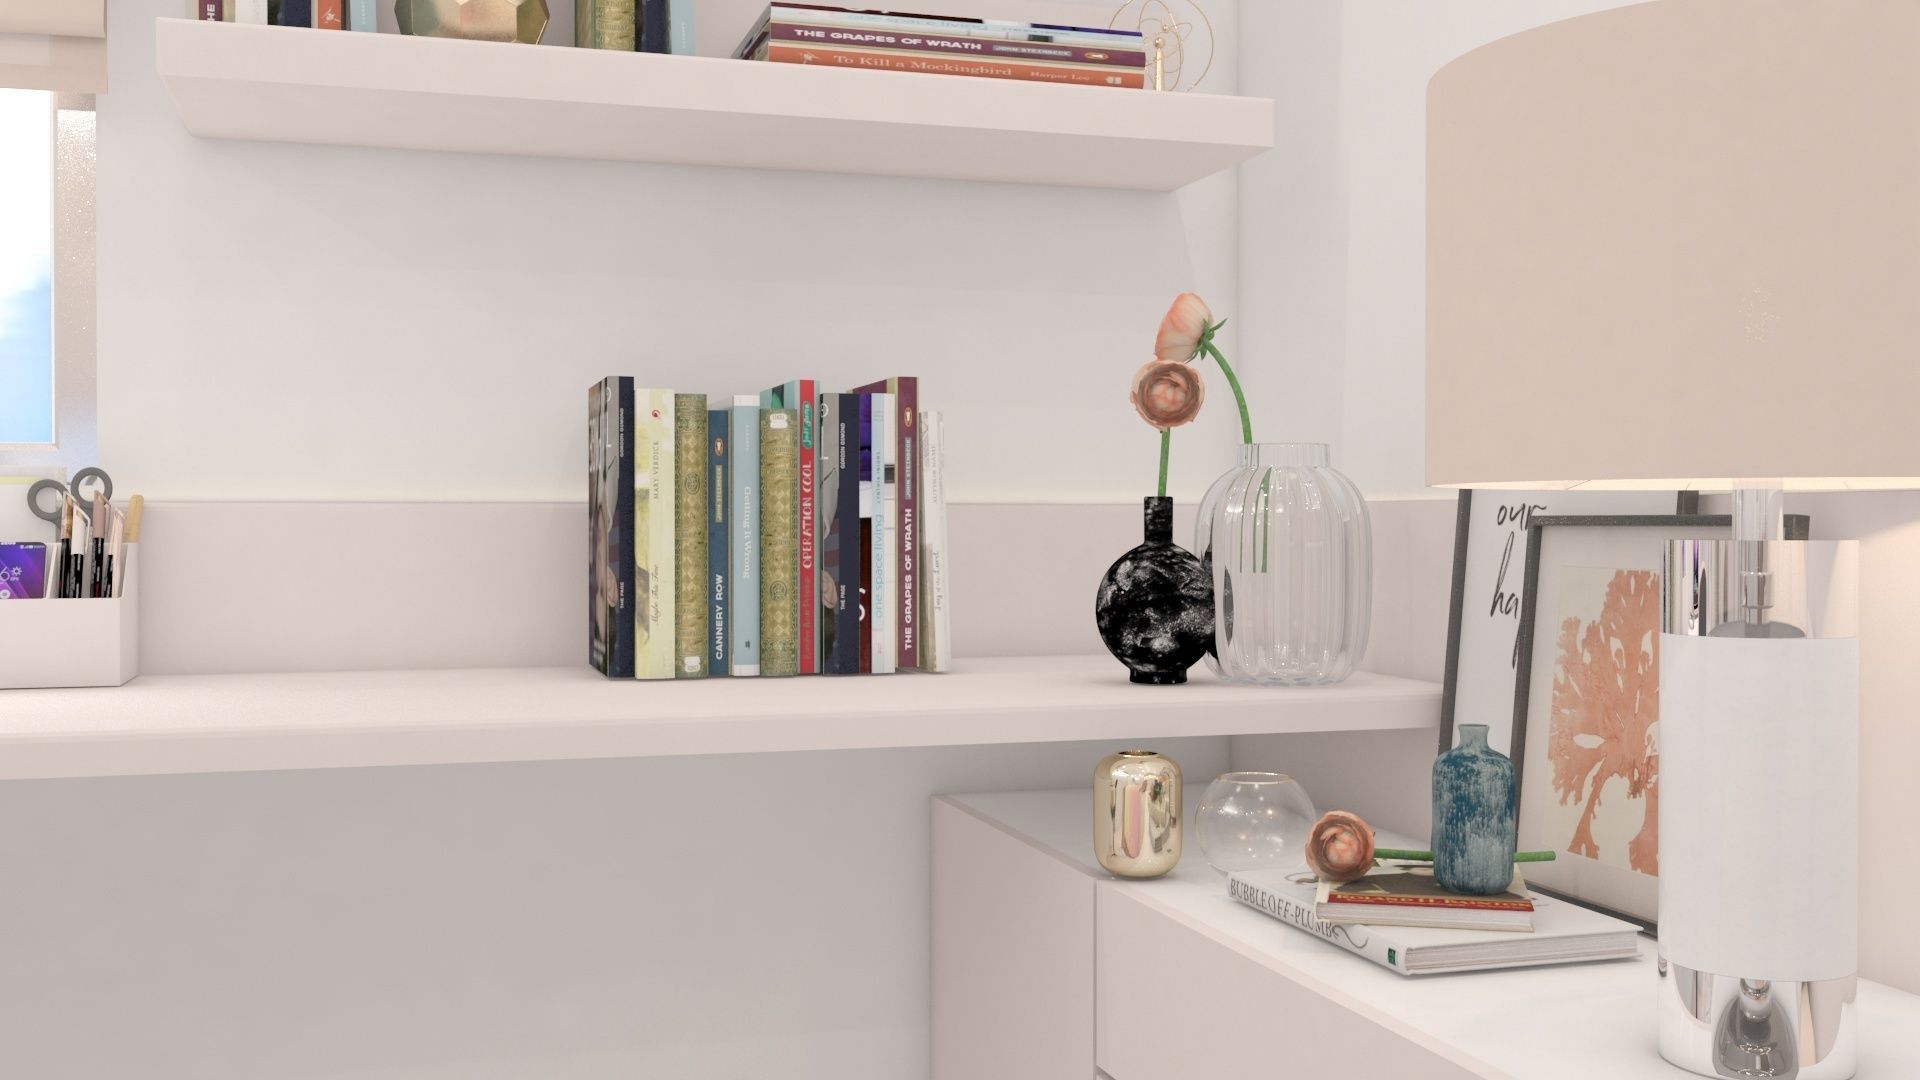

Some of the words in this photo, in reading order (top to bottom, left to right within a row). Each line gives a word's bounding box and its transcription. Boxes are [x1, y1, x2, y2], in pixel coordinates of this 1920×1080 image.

[207, 0, 215, 21] HE
[793, 28, 825, 38] THE
[830, 32, 896, 43] GRAPES
[901, 37, 923, 45] OF
[925, 39, 982, 50] WRATH
[833, 56, 854, 65] To
[858, 56, 892, 68] Kill
[896, 61, 905, 69] a
[910, 61, 1013, 77] Mockingbird
[1030, 71, 1068, 81] Harper
[802, 460, 812, 493] COOL
[742, 486, 752, 528] Getting
[1496, 502, 1547, 532] our
[744, 531, 752, 541] It
[802, 497, 812, 569] OPERATION
[871, 513, 885, 550] living
[904, 508, 912, 552] WRATH
[742, 541, 752, 579] Wrong
[873, 552, 885, 591] space
[904, 554, 912, 571] OF
[715, 573, 724, 601] ROW
[904, 574, 912, 624] GRAPES
[873, 592, 883, 618] one
[715, 605, 724, 660] CANNERY
